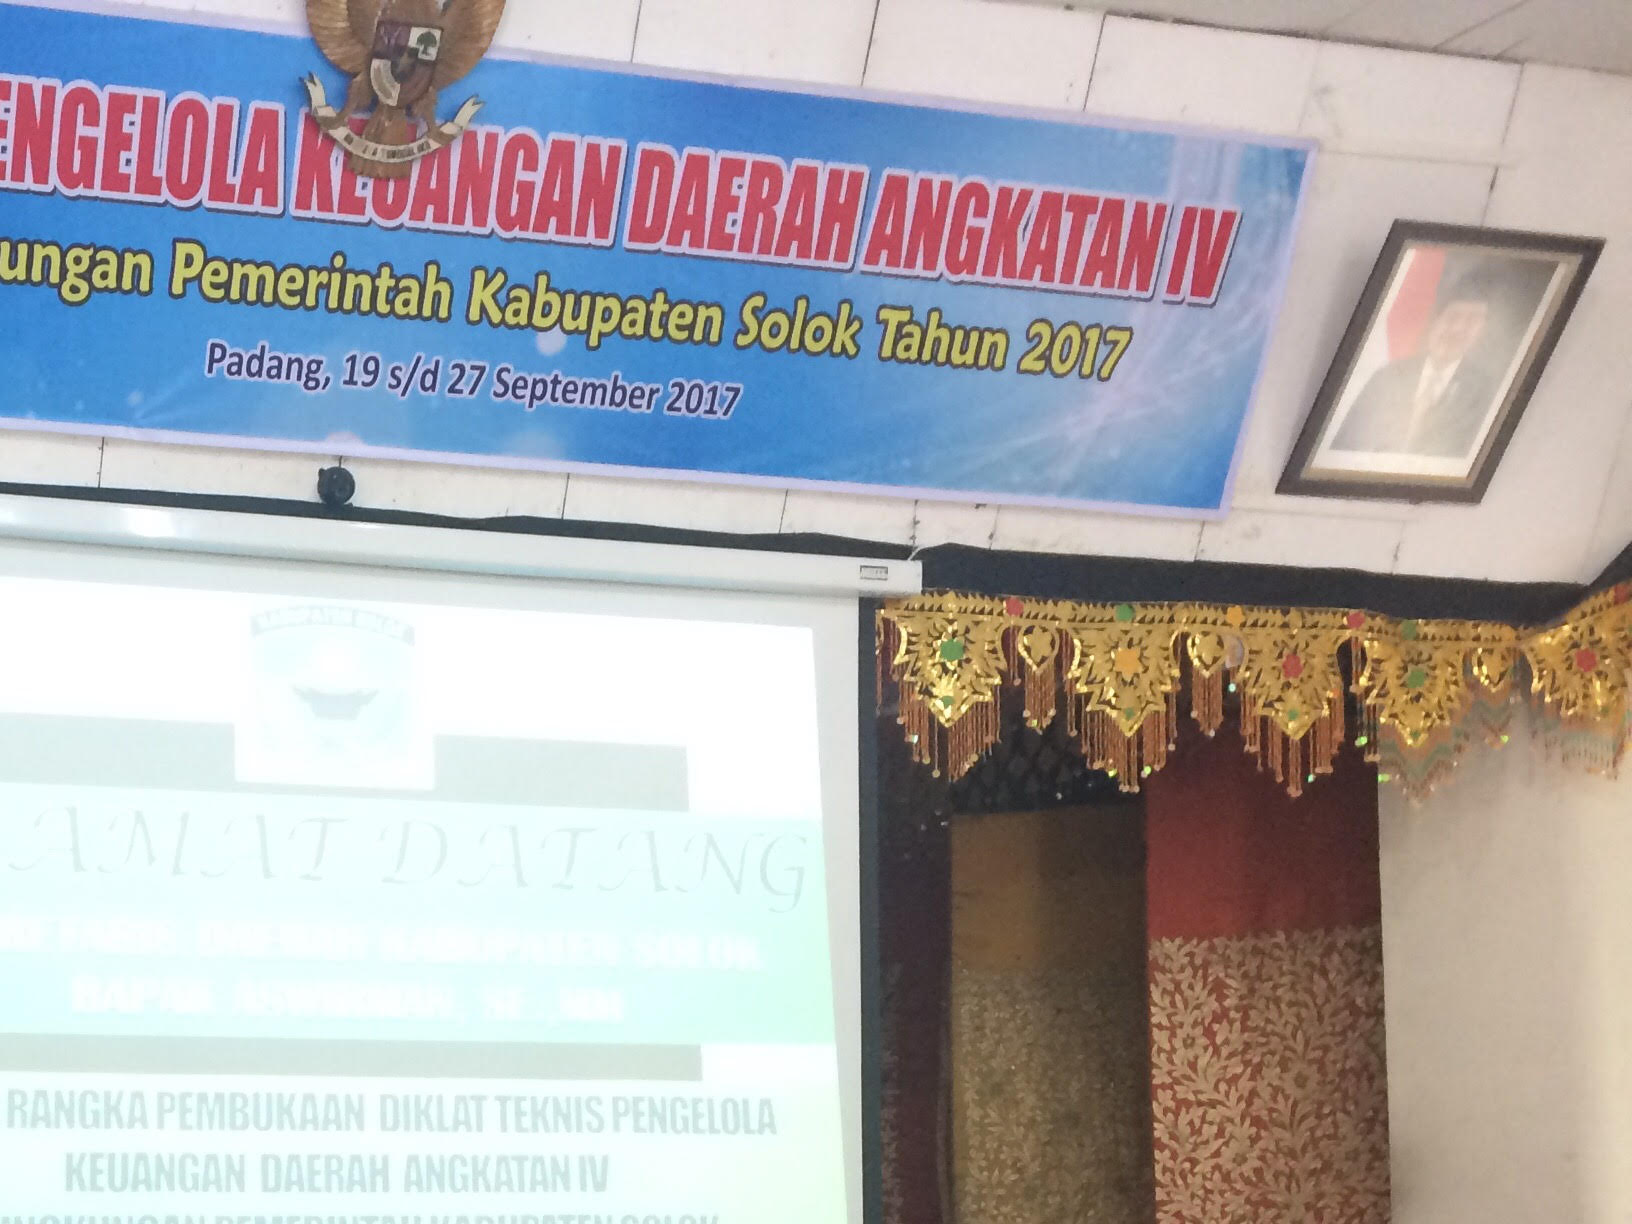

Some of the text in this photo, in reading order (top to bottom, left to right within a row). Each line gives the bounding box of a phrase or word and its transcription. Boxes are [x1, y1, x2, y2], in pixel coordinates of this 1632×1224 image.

[626, 147, 872, 267] DAERAH
[865, 172, 1168, 297] ANGKATAN
[1167, 202, 1240, 302] IV
[169, 239, 452, 320] Pemerintah
[465, 266, 722, 350] Kabupaten
[736, 296, 859, 356] Solok
[877, 307, 1007, 373] Tahun
[1018, 321, 1132, 382] 2017
[206, 341, 741, 418] Padang, 19 s/d 27 September 2017
[378, 817, 808, 913] DATANG
[6, 1088, 150, 1131] RANGKA
[156, 1089, 365, 1132] PEMBUKAAN
[378, 1093, 488, 1133] DIKLAT
[495, 1094, 606, 1134] TEKNIS
[612, 1097, 778, 1136] PENGELOLA
[65, 1152, 610, 1193] KEUANGAN DAERAH ANGKATAN IV
